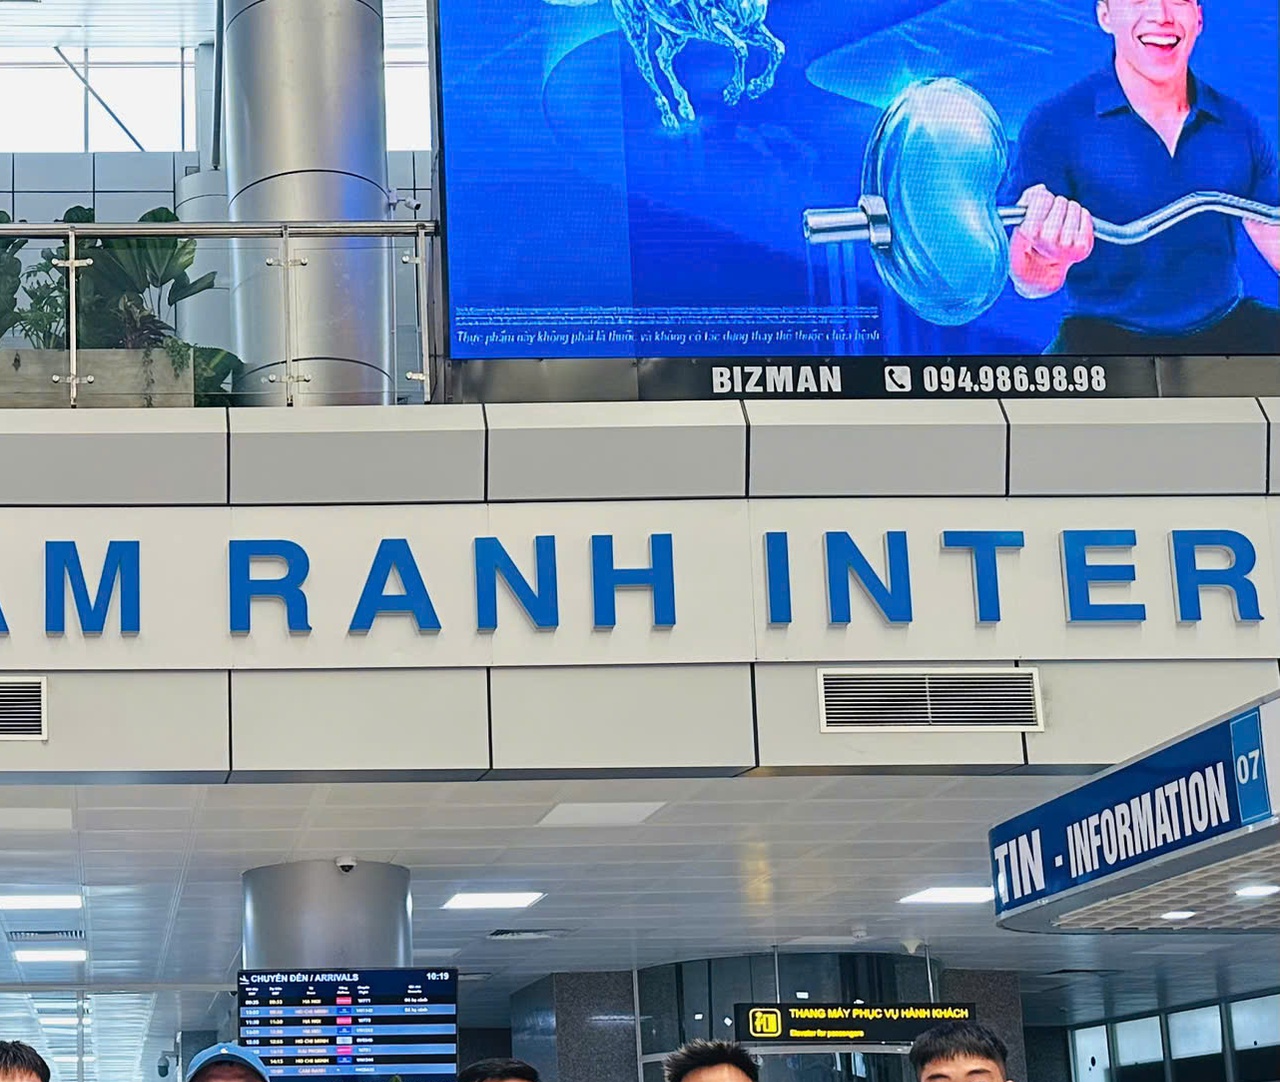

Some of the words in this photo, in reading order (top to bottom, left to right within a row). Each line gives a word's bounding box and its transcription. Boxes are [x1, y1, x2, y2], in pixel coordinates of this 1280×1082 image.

[712, 366, 842, 393] BIZMAN
[924, 366, 1107, 392] 094.986.98.98
[229, 534, 677, 634] RANH
[764, 529, 1265, 625] INTER
[1236, 749, 1261, 785] 07
[994, 829, 1046, 905] TIN
[1067, 762, 1230, 879] INFORMATION
[315, 973, 359, 981] ARRIVALS
[426, 972, 449, 980] 10:19
[789, 1009, 826, 1018] THANG
[828, 1007, 850, 1018] MÁY
[852, 1009, 882, 1019] PHỤC
[885, 1009, 899, 1020] VỤ
[901, 1007, 930, 1018] HÀNH
[932, 1007, 968, 1018] KHÁCH
